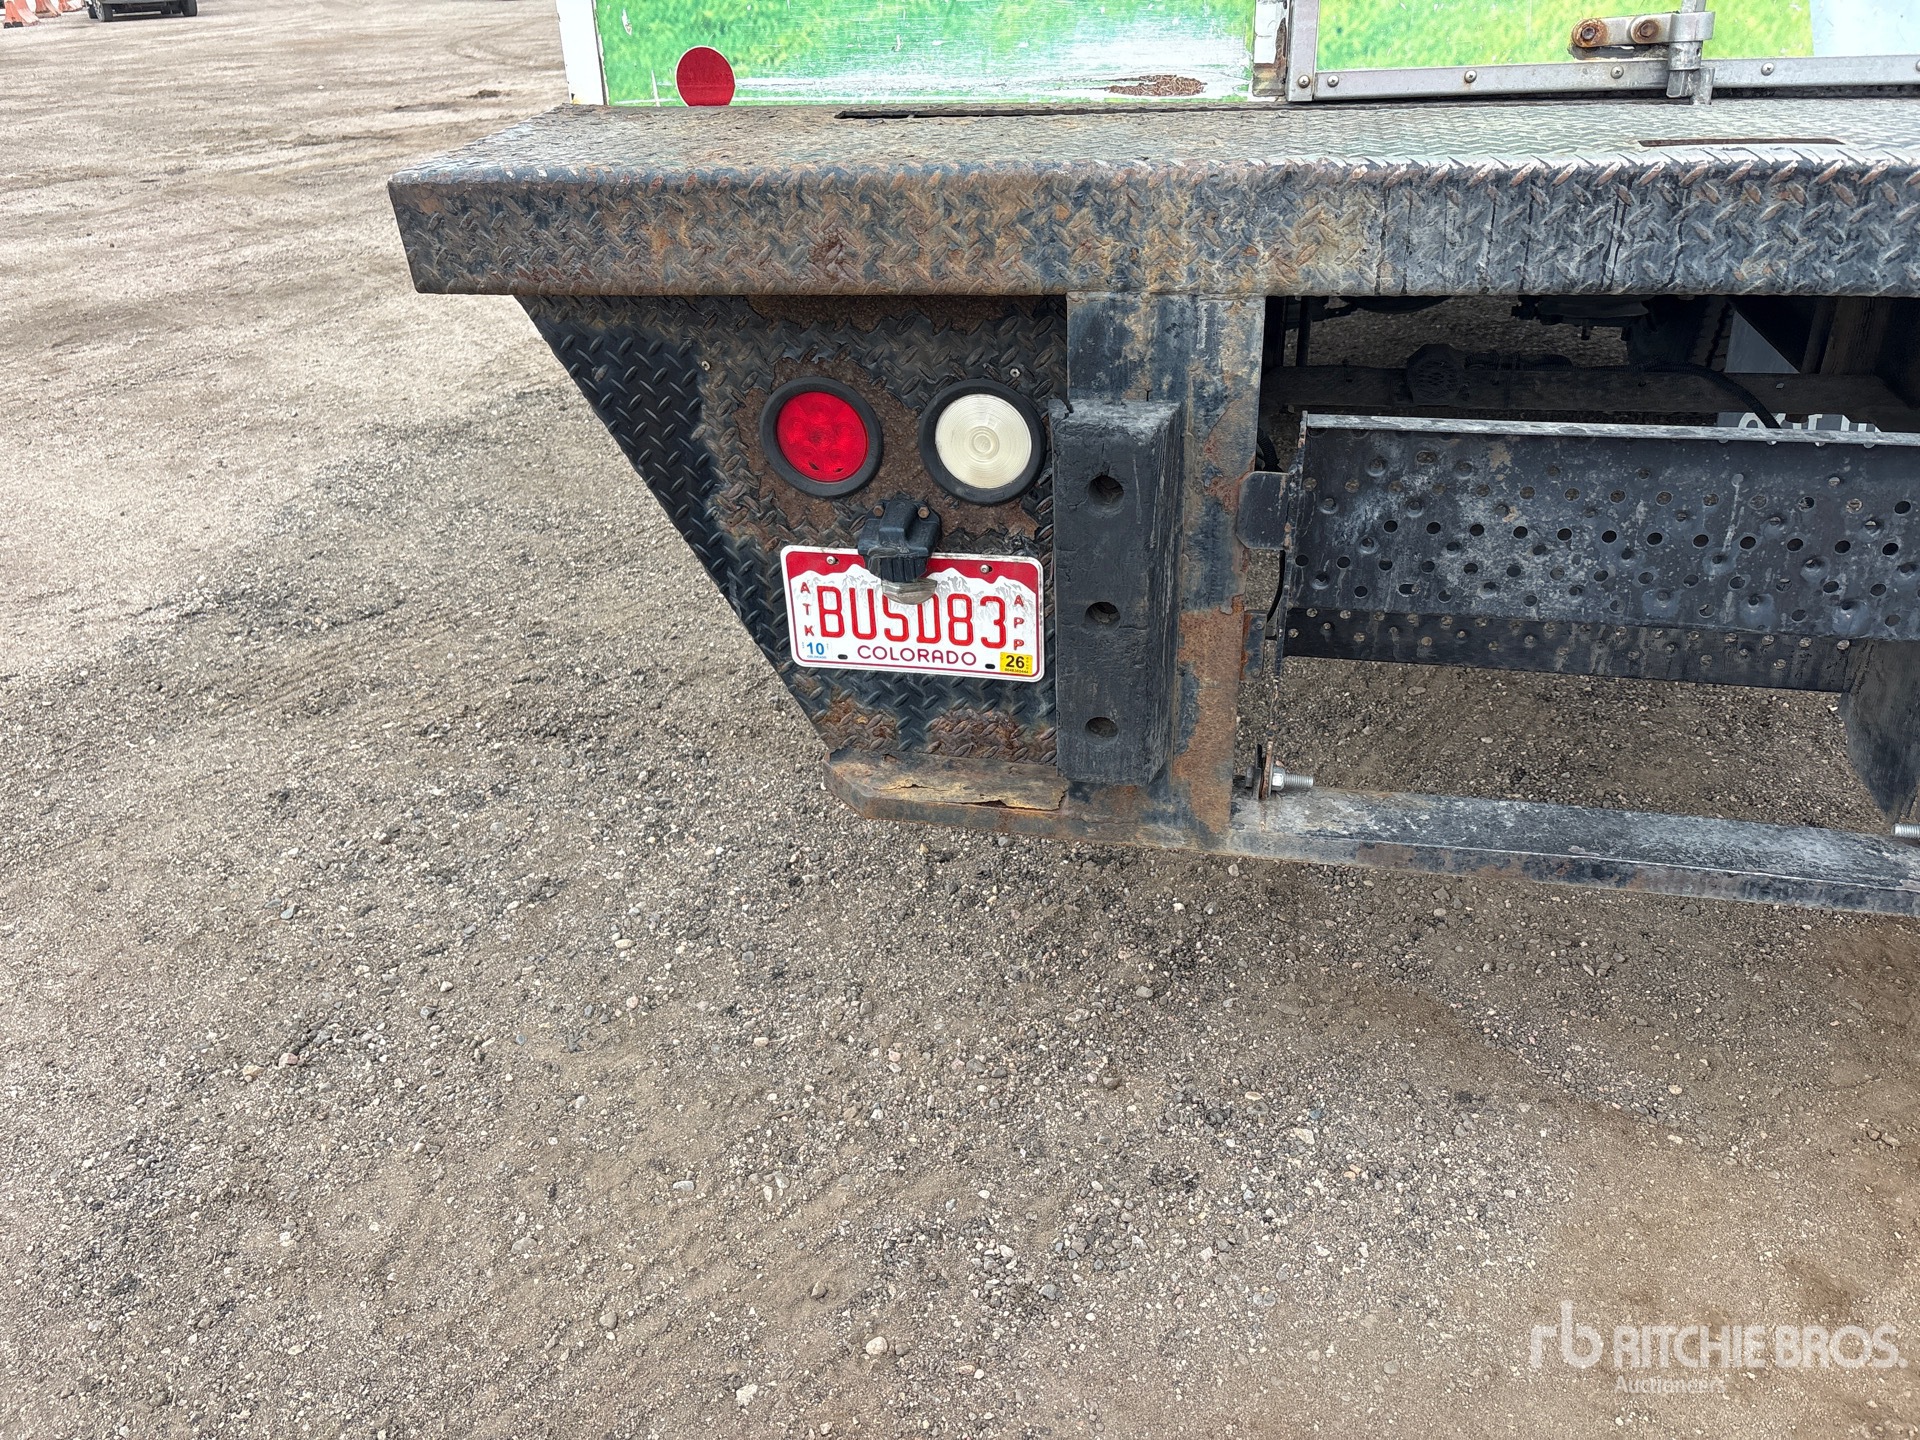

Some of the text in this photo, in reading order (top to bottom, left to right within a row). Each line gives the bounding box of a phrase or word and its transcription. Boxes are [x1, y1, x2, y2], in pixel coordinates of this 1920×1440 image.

[806, 641, 826, 656] 10
[857, 644, 978, 667] COLORADO
[1005, 654, 1026, 669] 26
